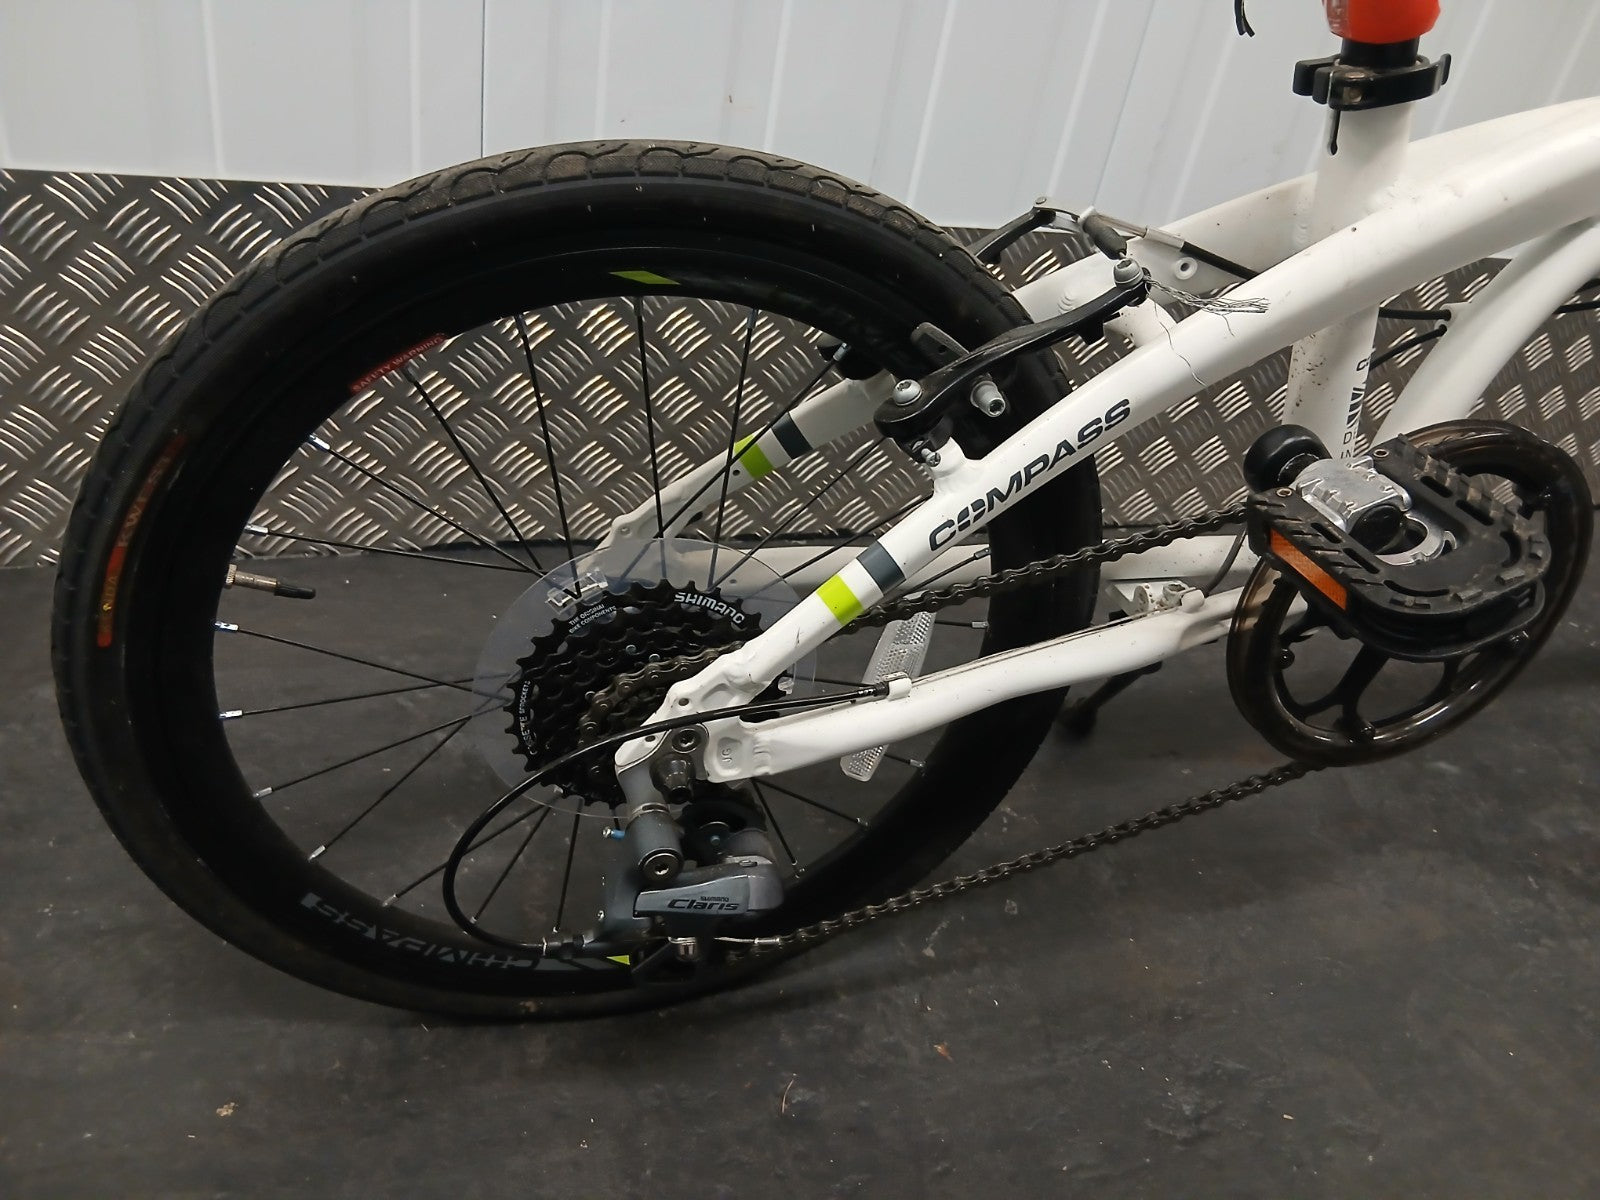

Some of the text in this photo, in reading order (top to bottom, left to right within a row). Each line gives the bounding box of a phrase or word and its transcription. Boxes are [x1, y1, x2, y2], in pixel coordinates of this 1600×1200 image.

[352, 336, 444, 391] SAFETY WARNING
[929, 398, 1131, 552] COMPASS
[568, 603, 605, 627] THE ORIGINAL
[581, 605, 617, 628] COMPONENTS
[674, 592, 745, 625] SHIMANO
[667, 898, 739, 911] Claris
